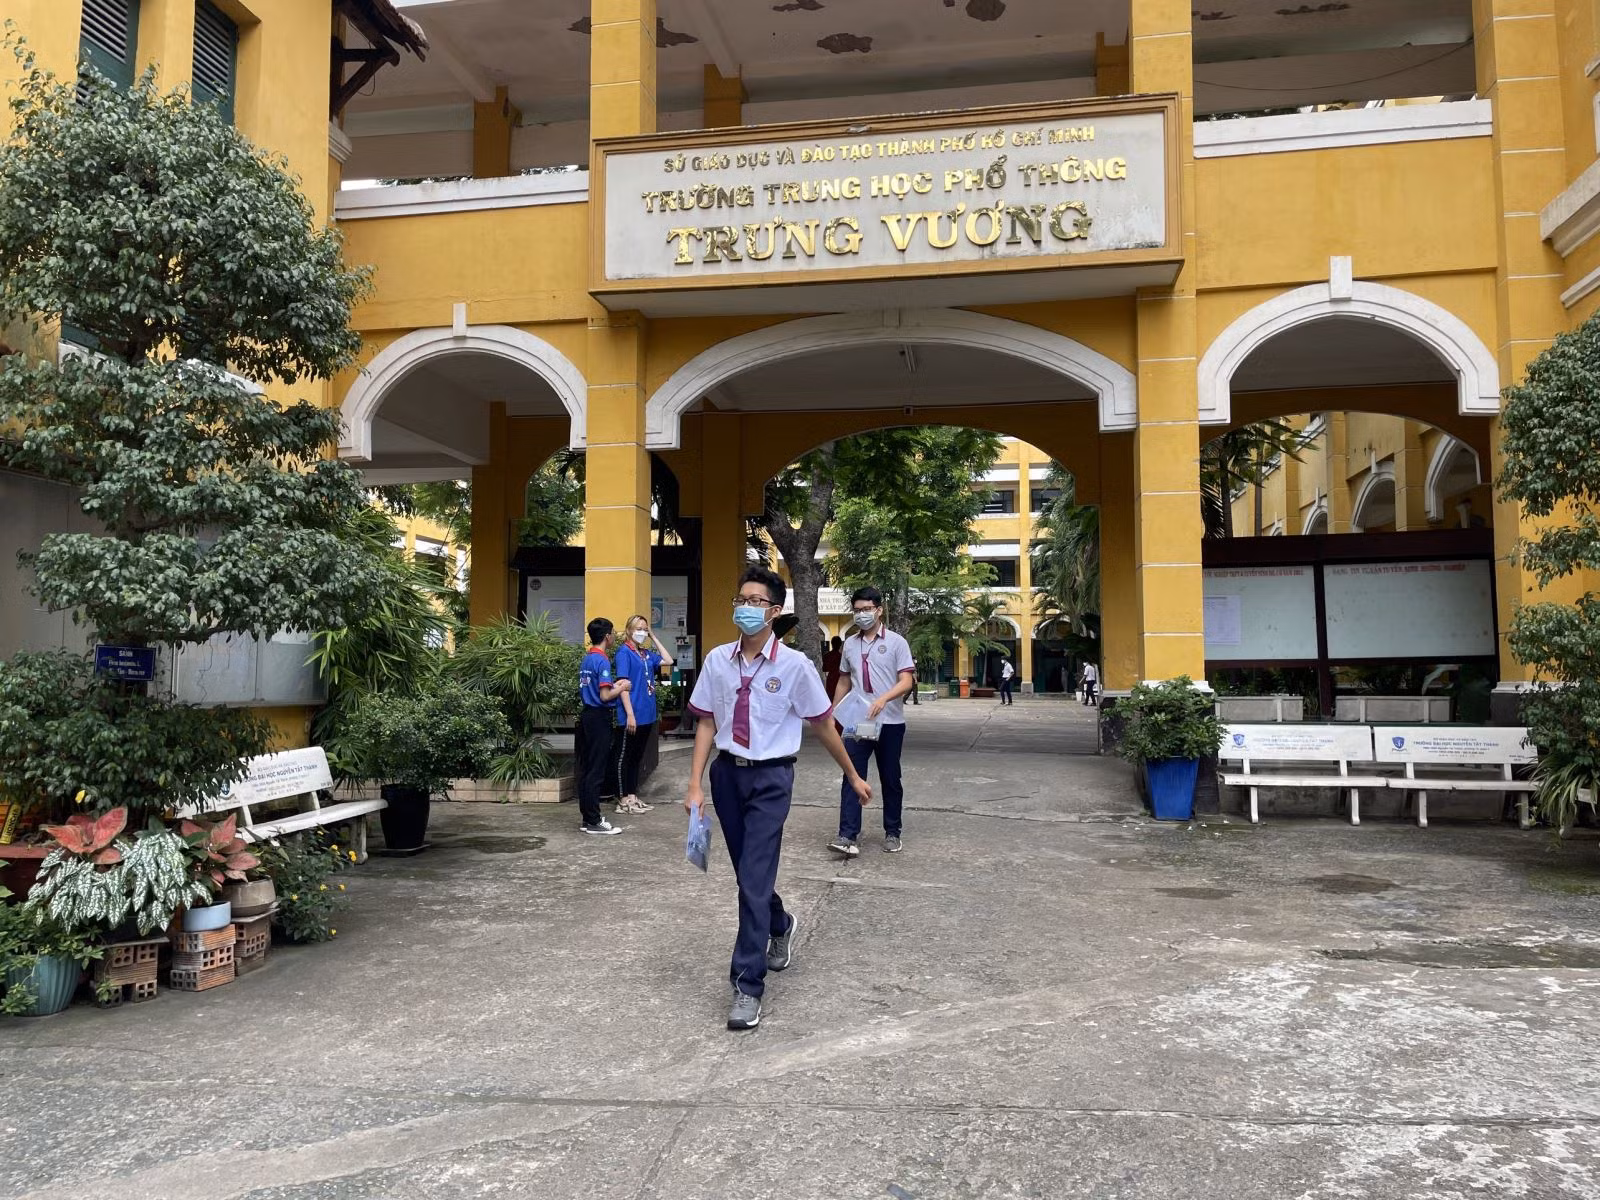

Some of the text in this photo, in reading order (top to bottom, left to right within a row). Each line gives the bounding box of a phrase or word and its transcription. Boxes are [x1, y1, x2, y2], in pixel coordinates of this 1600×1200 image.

[664, 126, 1095, 173] SỞ GIÁO DỤC VÀ ĐÀO TẠO THÀNH PHỐ HỒ CHÍ MINH
[641, 154, 1127, 213] TRƯỜNG TRUNG HỌC PHỐ THÔNG
[666, 199, 1093, 265] TRƯNG VƯƠNG
